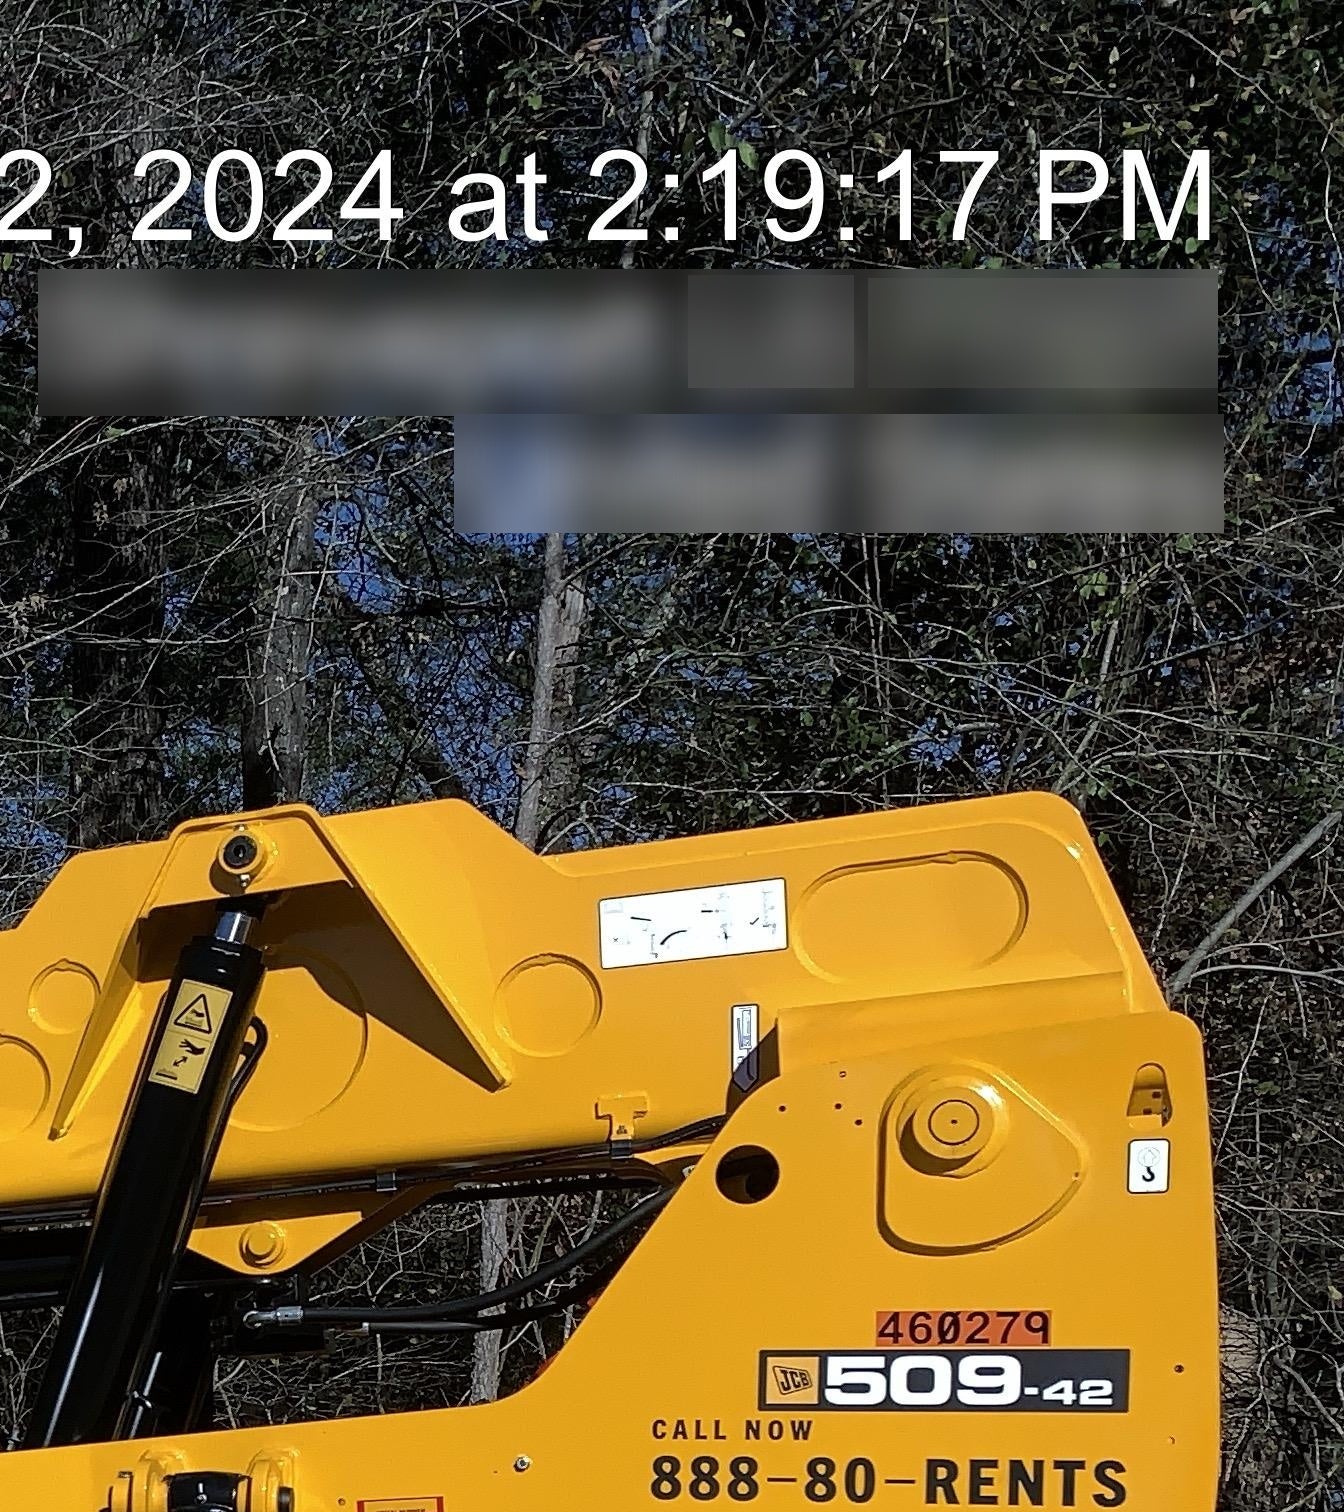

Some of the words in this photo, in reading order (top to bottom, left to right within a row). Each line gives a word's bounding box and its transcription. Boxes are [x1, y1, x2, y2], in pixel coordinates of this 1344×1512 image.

[878, 1311, 1050, 1345] 460279
[779, 1368, 810, 1392] JCB
[823, 1355, 1114, 1407] 509-42
[651, 1418, 727, 1441] CALL
[744, 1418, 813, 1442] NOW
[650, 1454, 1128, 1508] 888-80-RENTS
